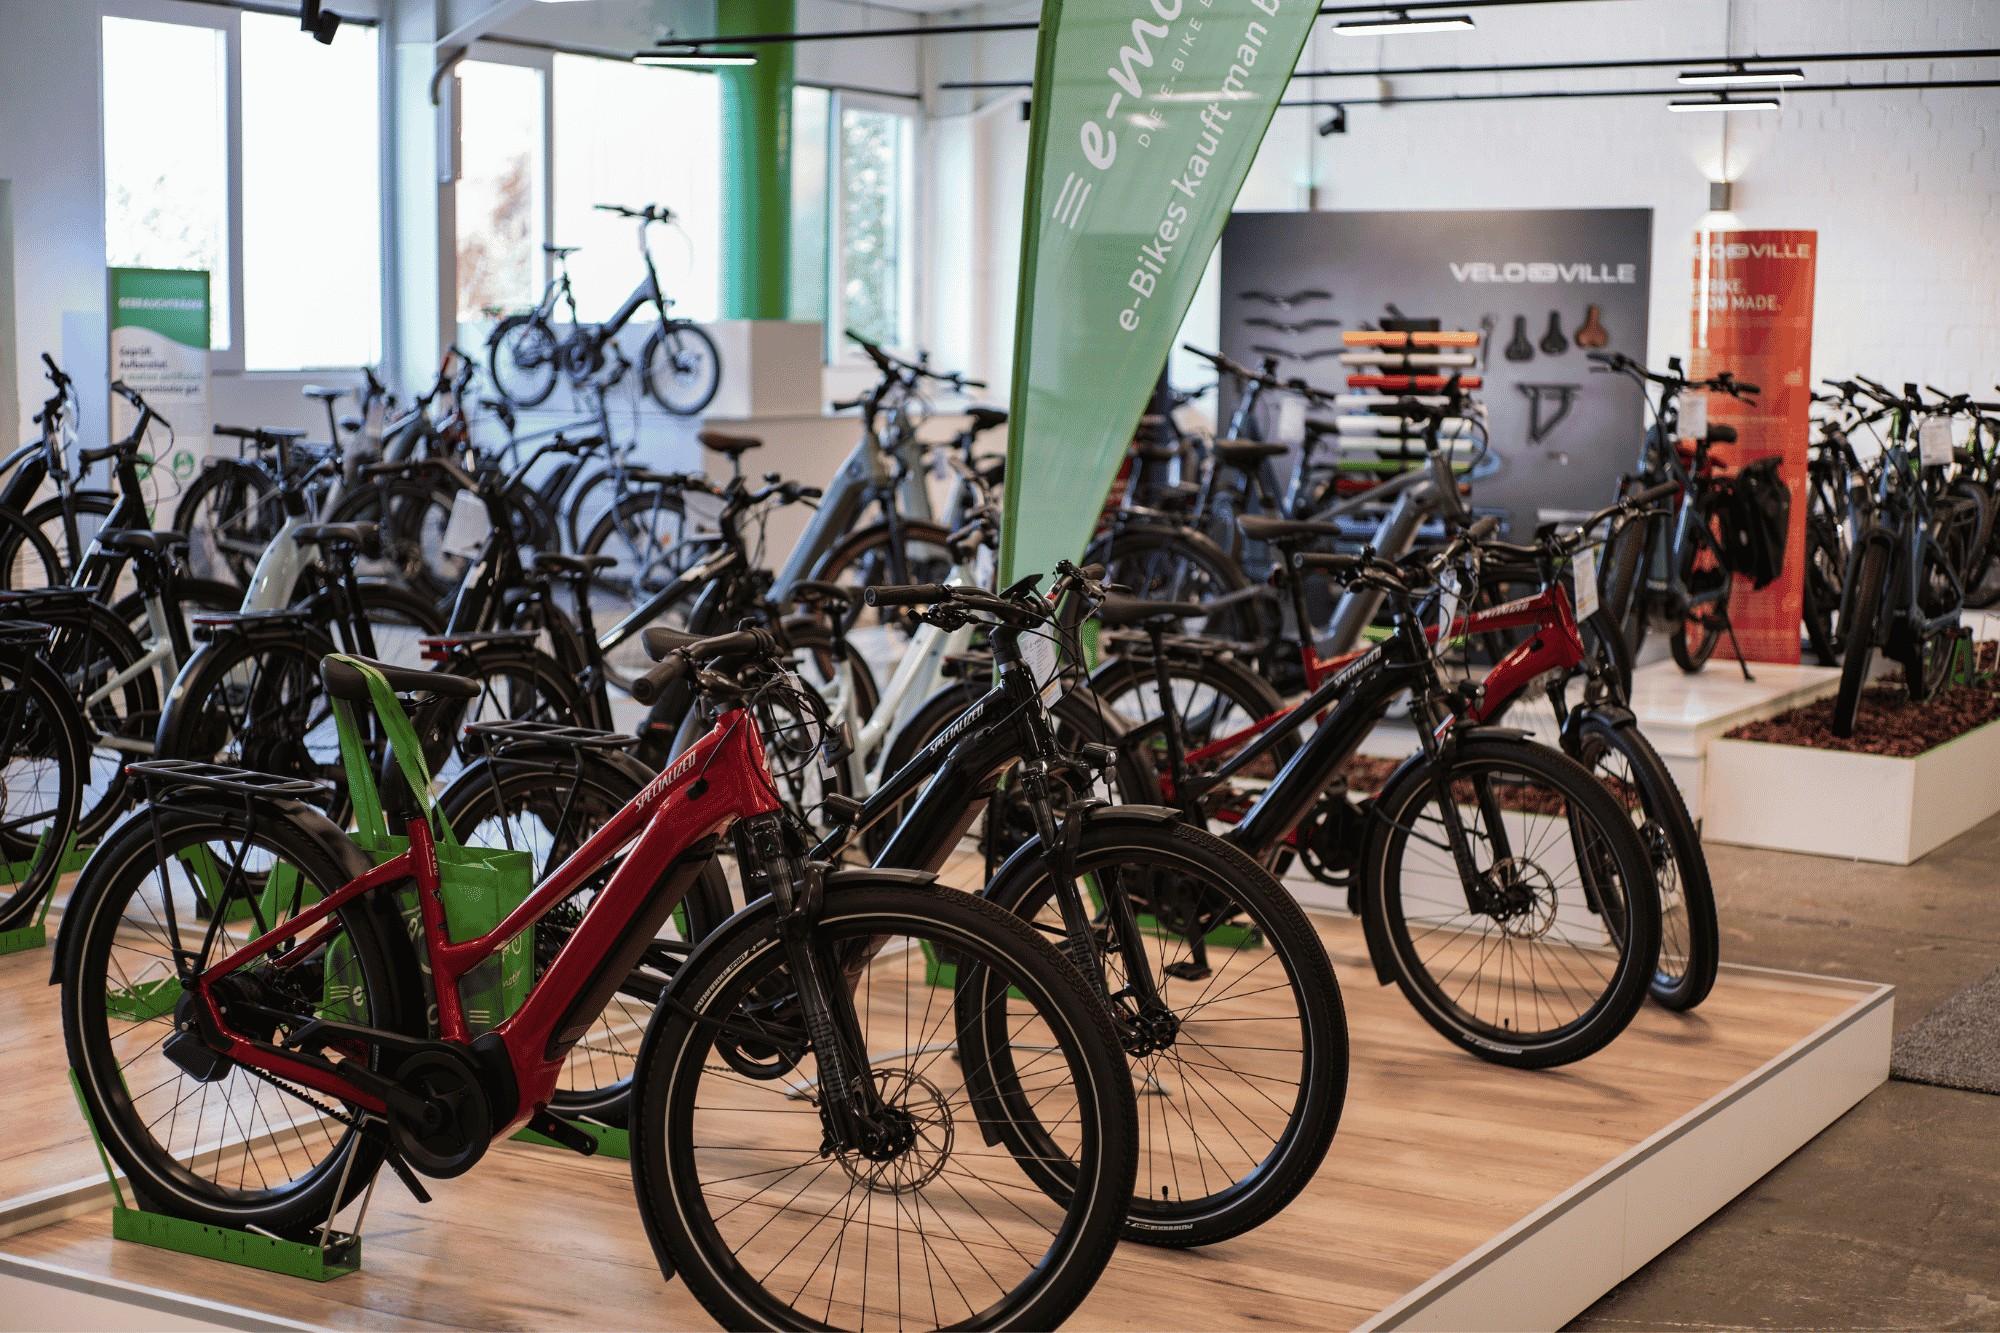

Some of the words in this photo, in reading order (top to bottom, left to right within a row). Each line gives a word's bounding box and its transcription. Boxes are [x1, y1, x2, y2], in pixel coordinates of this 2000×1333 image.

[1119, 201, 1188, 331] e-Bikes
[1171, 102, 1233, 198] kauft
[1221, 21, 1268, 100] man
[930, 703, 984, 757] SPECIALIZED
[635, 749, 697, 813] SPECIALIZED
